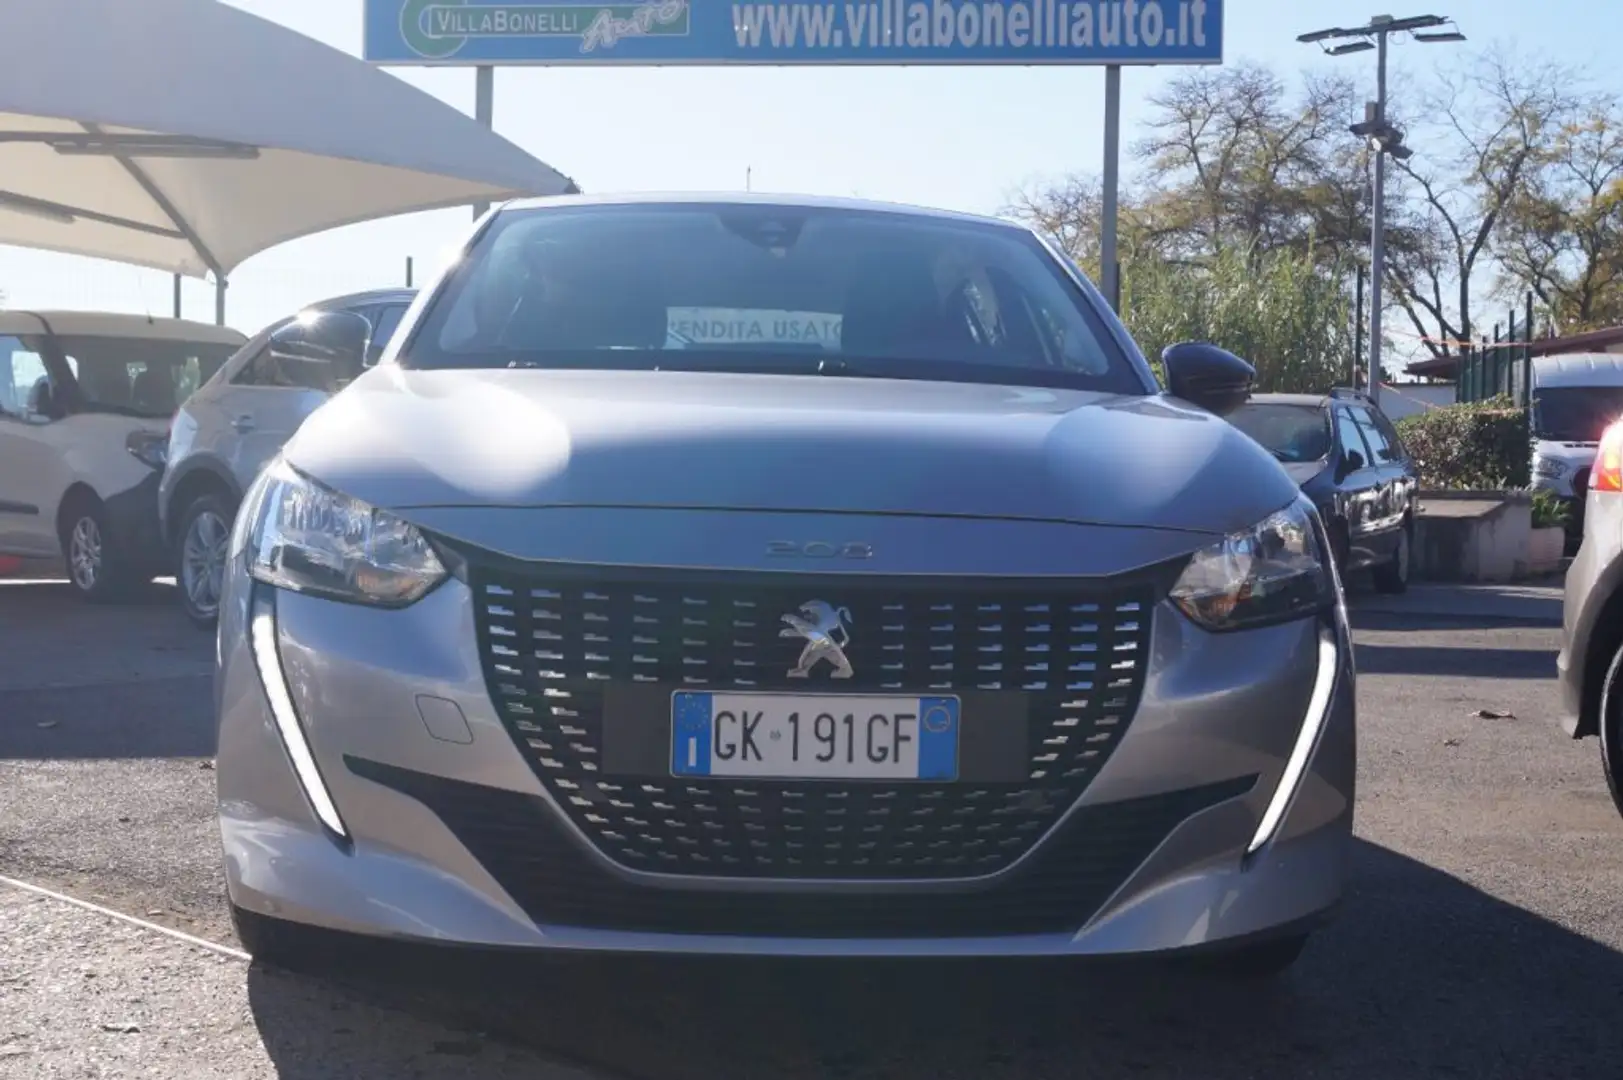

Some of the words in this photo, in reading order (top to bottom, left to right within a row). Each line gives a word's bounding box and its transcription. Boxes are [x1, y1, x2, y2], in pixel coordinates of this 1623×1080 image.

[732, 0, 1207, 48] www.villabonelliauto.it
[765, 541, 873, 559] 208
[714, 710, 763, 761] GK
[788, 712, 916, 764] 191GF
